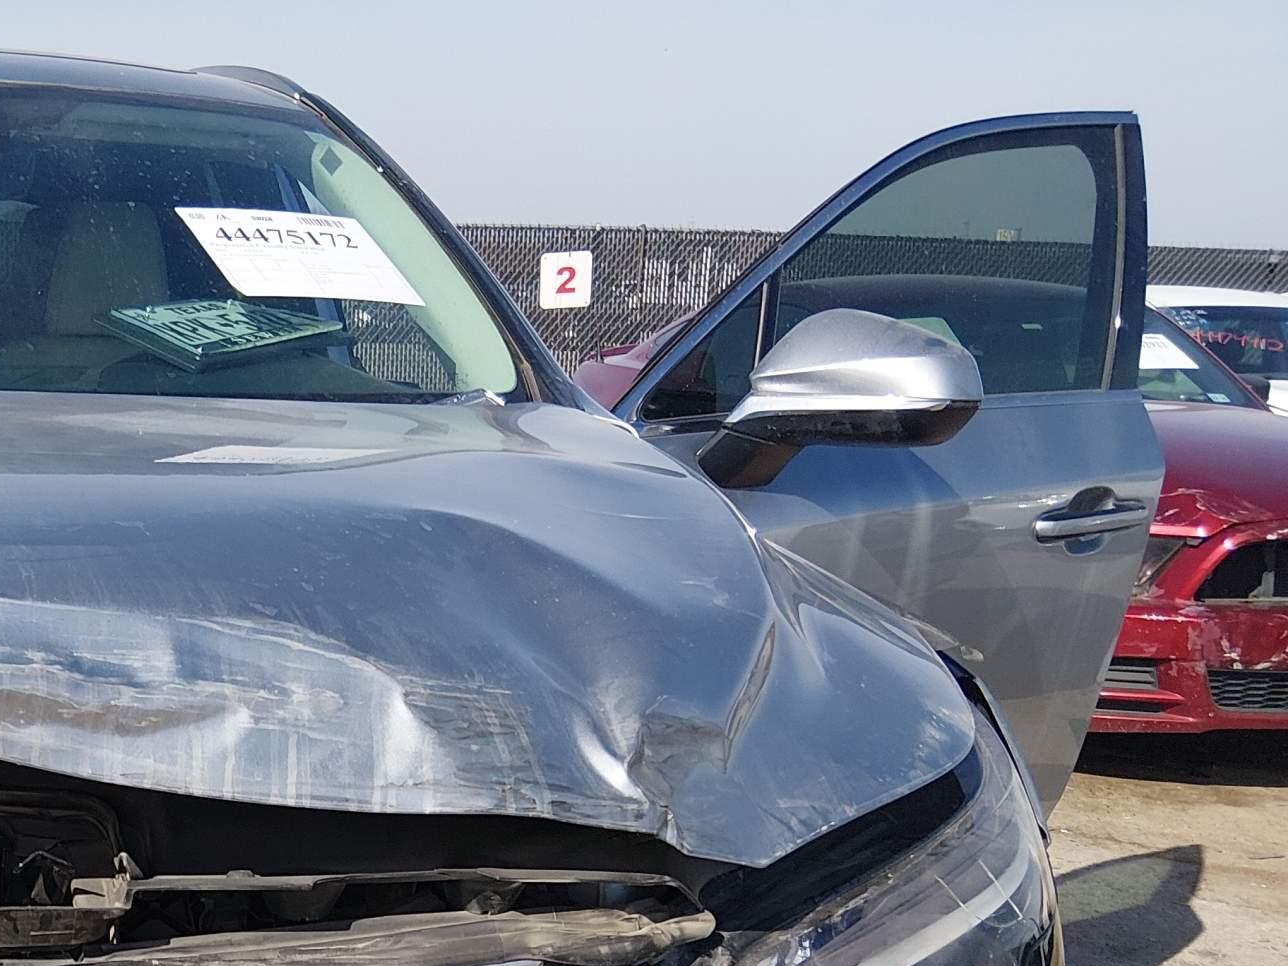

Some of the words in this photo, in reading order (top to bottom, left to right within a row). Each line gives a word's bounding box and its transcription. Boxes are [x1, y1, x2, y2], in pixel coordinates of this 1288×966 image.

[215, 227, 358, 249] 44475172
[555, 266, 577, 294] 2
[163, 303, 227, 316] TEXAS
